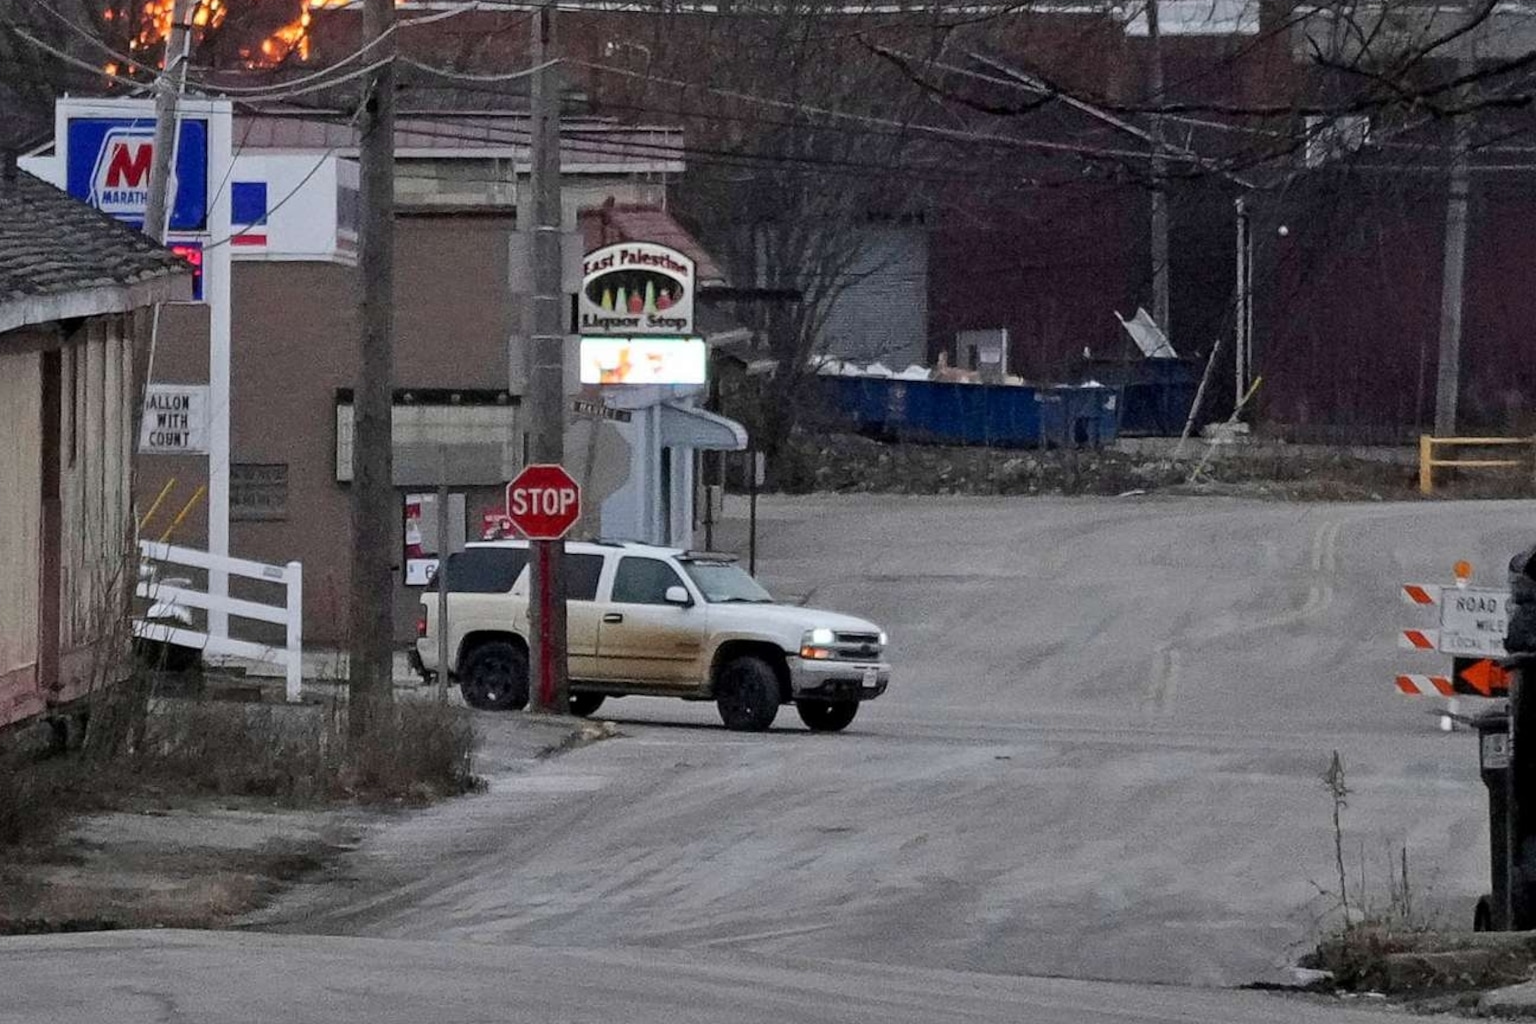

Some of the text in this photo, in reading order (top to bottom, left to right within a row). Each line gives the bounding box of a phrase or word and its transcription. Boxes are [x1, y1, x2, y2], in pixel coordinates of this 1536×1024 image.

[102, 190, 148, 205] MARATH
[584, 249, 688, 276] East Palestine
[583, 314, 687, 330] Liquor Stop
[157, 413, 188, 428] WITH
[512, 487, 575, 515] STOP
[1456, 597, 1497, 613] ROAD
